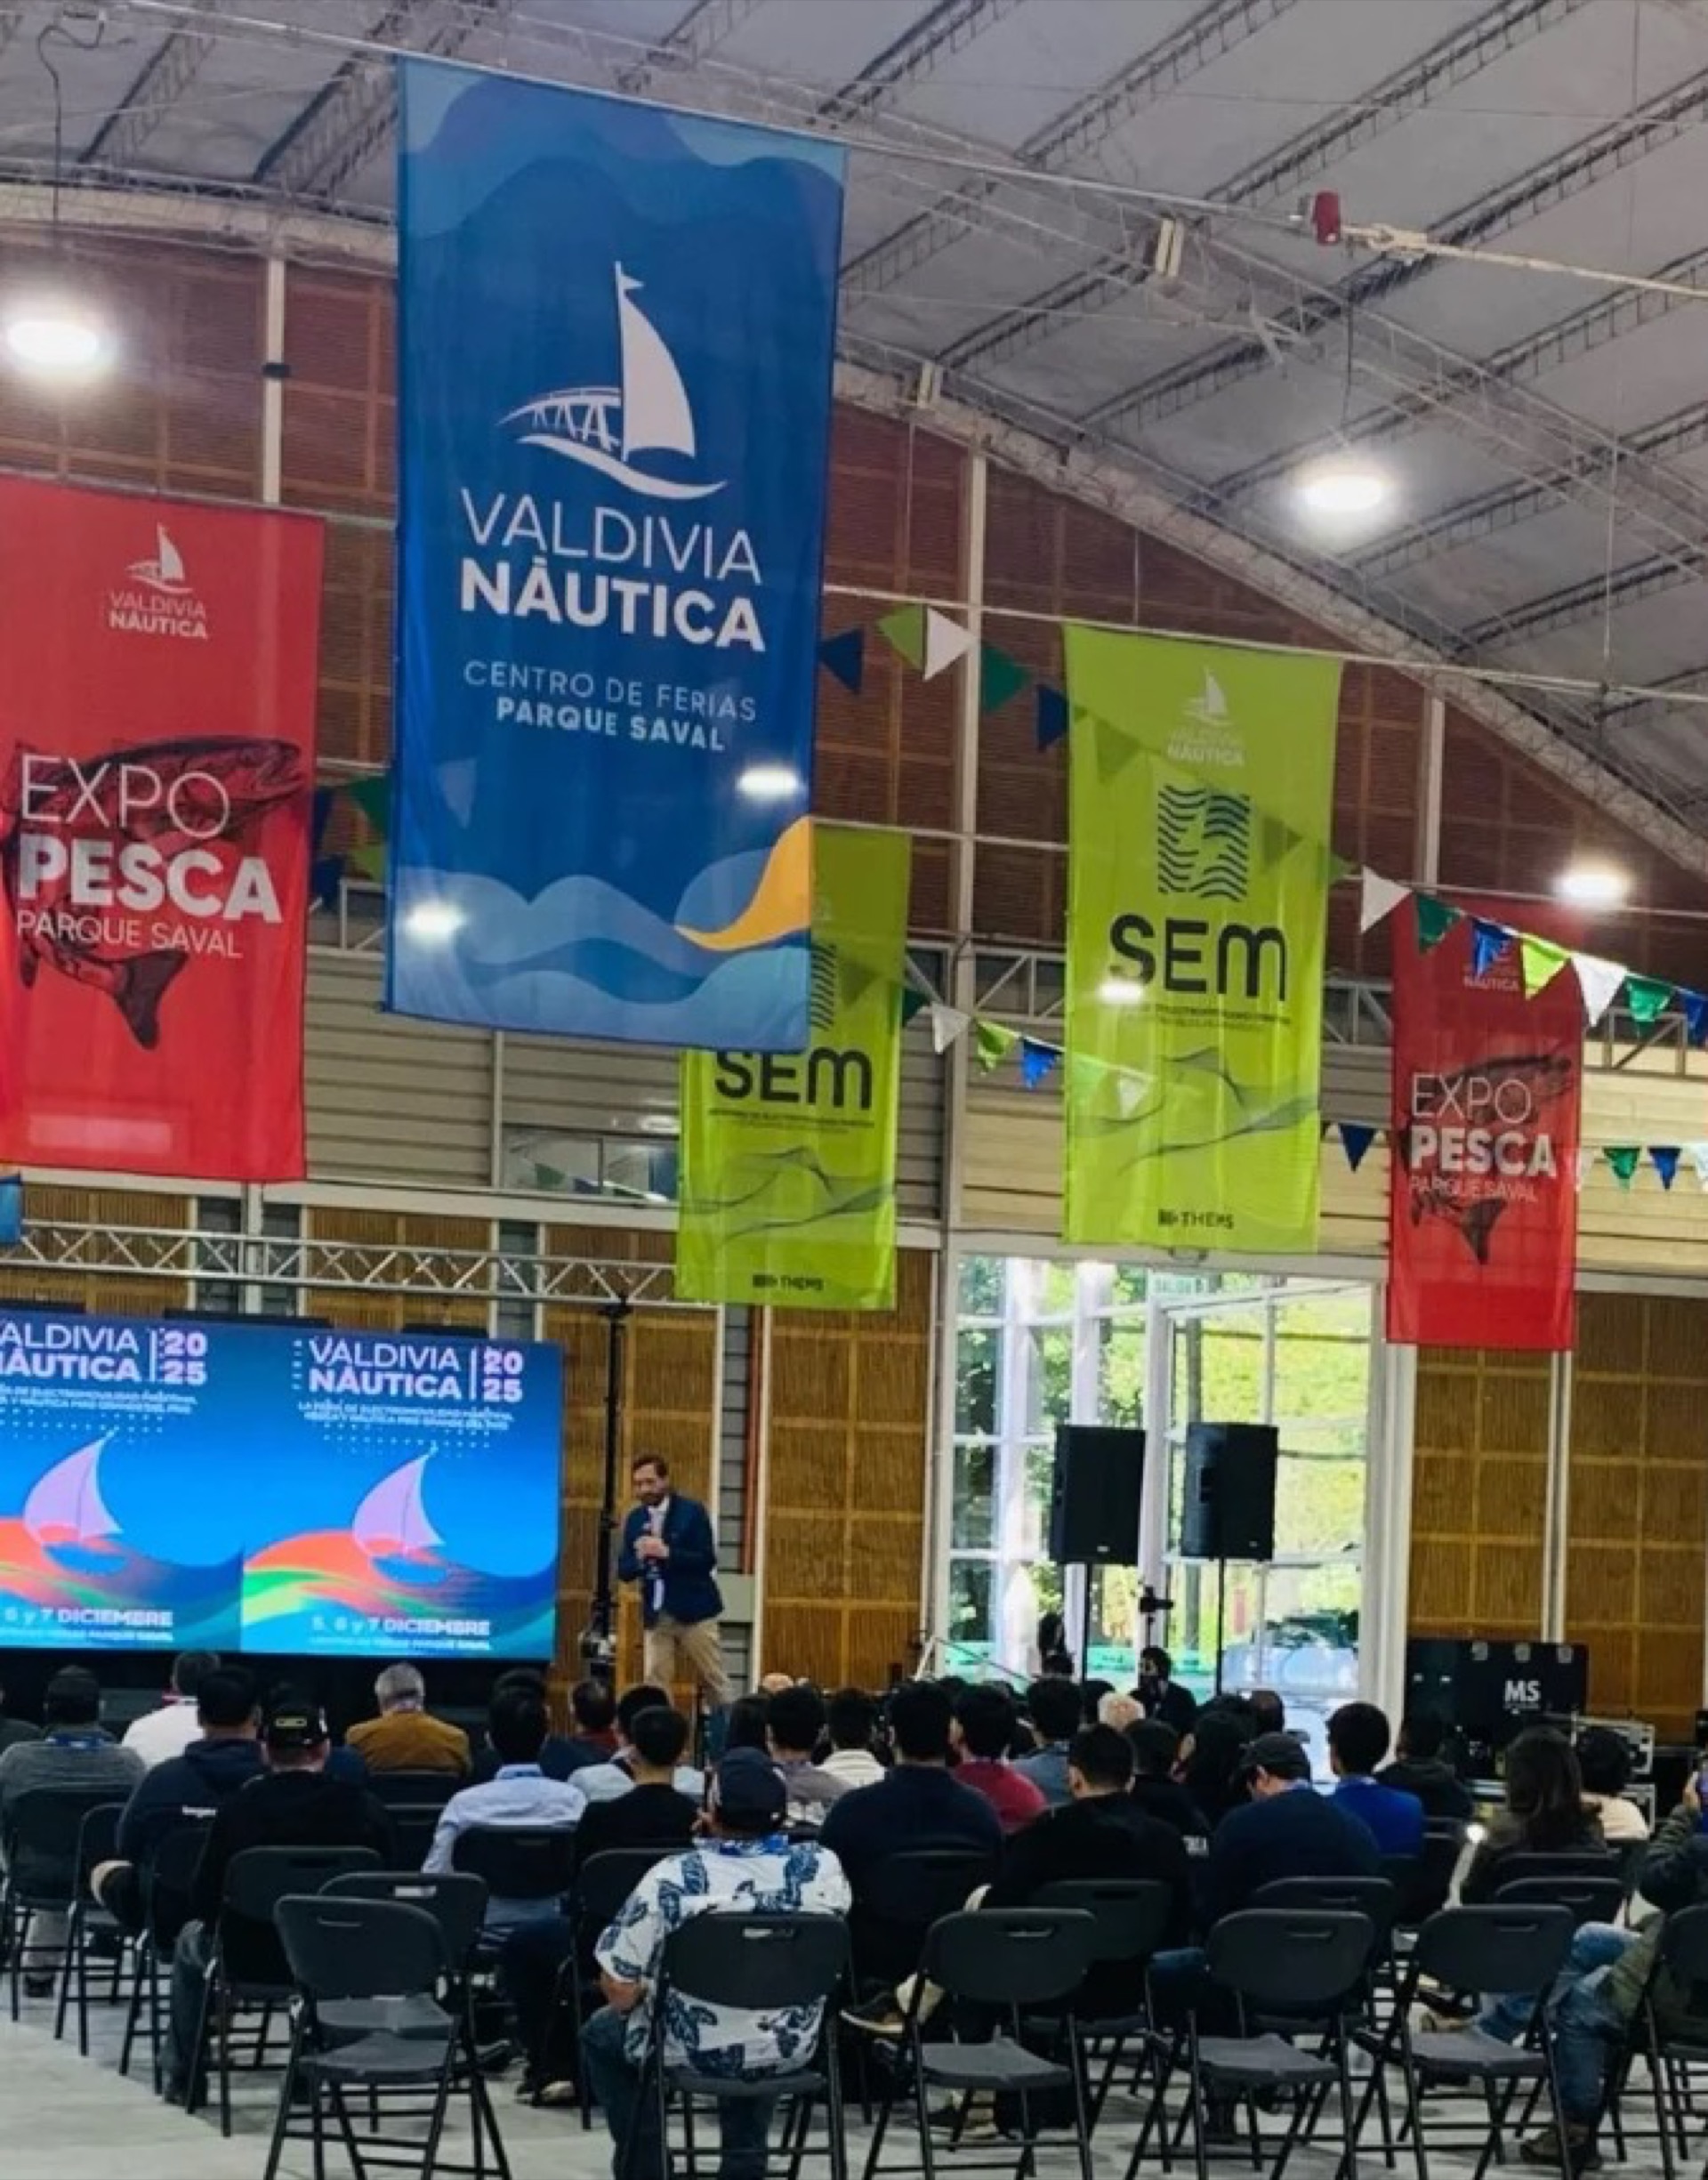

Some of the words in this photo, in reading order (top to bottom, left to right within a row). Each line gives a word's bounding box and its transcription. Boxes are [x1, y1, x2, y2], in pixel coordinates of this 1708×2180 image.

[461, 488, 761, 585] VALDIVIA
[110, 590, 206, 620] VALDIVIA
[464, 660, 593, 698] CENTRO
[606, 678, 642, 706] DE
[657, 684, 756, 722] FERIAS
[497, 697, 618, 735] PARQUE
[630, 716, 725, 751] SAVAL
[21, 754, 229, 839] EXPO
[18, 834, 282, 924] PESCA
[17, 909, 141, 948] PARQUE
[151, 923, 243, 958] SAVAL
[1412, 1072, 1531, 1124] EXPO
[1410, 1126, 1557, 1177] PESCA
[0, 1320, 140, 1353] ALDIVIA
[164, 1330, 207, 1357] 20
[310, 1336, 461, 1371] VALDIVIA
[164, 1360, 208, 1386] 25
[483, 1348, 523, 1376] 20
[483, 1377, 523, 1403] 25
[58, 1608, 173, 1627] DICIEMBRE
[1504, 1680, 1541, 1703] MS
